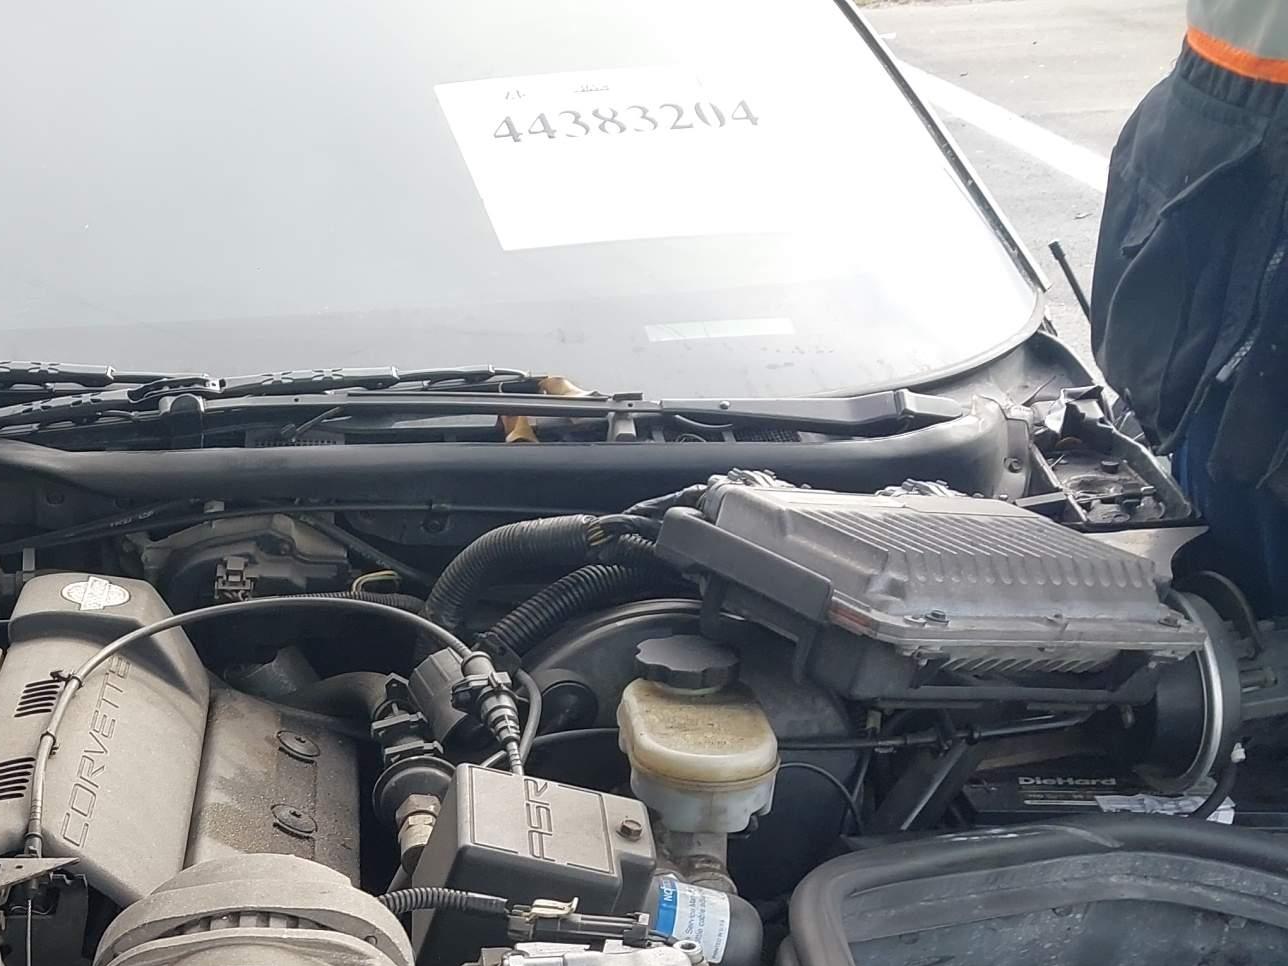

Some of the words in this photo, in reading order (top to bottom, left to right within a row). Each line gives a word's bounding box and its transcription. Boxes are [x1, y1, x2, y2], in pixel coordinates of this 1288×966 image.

[493, 100, 759, 143] 44383204
[59, 655, 131, 849] CORVETTE
[1018, 776, 1116, 786] DieHard
[523, 778, 556, 862] ASR
